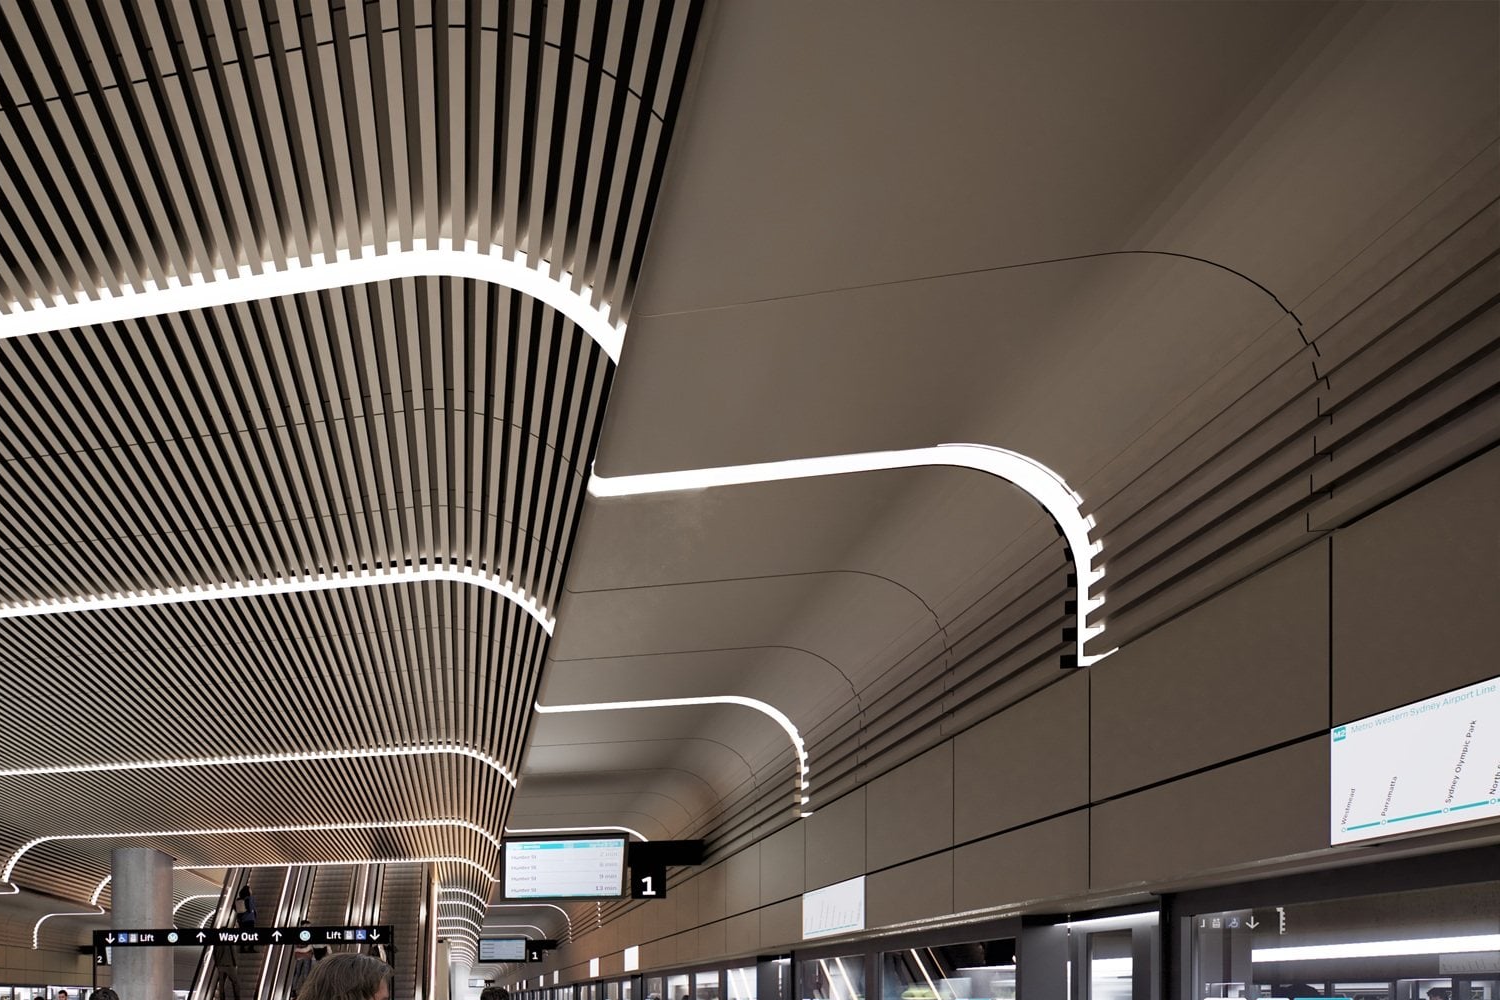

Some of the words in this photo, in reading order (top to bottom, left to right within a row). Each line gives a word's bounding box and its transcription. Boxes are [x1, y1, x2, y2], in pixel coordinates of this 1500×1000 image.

[1351, 721, 1373, 734] Metro
[1375, 711, 1409, 726] Western
[1410, 702, 1440, 717] Sydney
[1442, 691, 1474, 706] Airport
[1476, 684, 1496, 697] Line
[1445, 775, 1460, 804] Sydney
[1454, 740, 1470, 773] Olympic
[1466, 720, 1477, 738] Park
[1381, 776, 1398, 817] Parramatta
[1341, 788, 1355, 825] Westmead
[641, 876, 656, 896] 1
[140, 934, 154, 942] Lift
[219, 932, 240, 943] Way
[241, 932, 259, 941] Out
[326, 931, 342, 940] Lift
[97, 955, 103, 963] 2
[532, 952, 538, 960] 1
